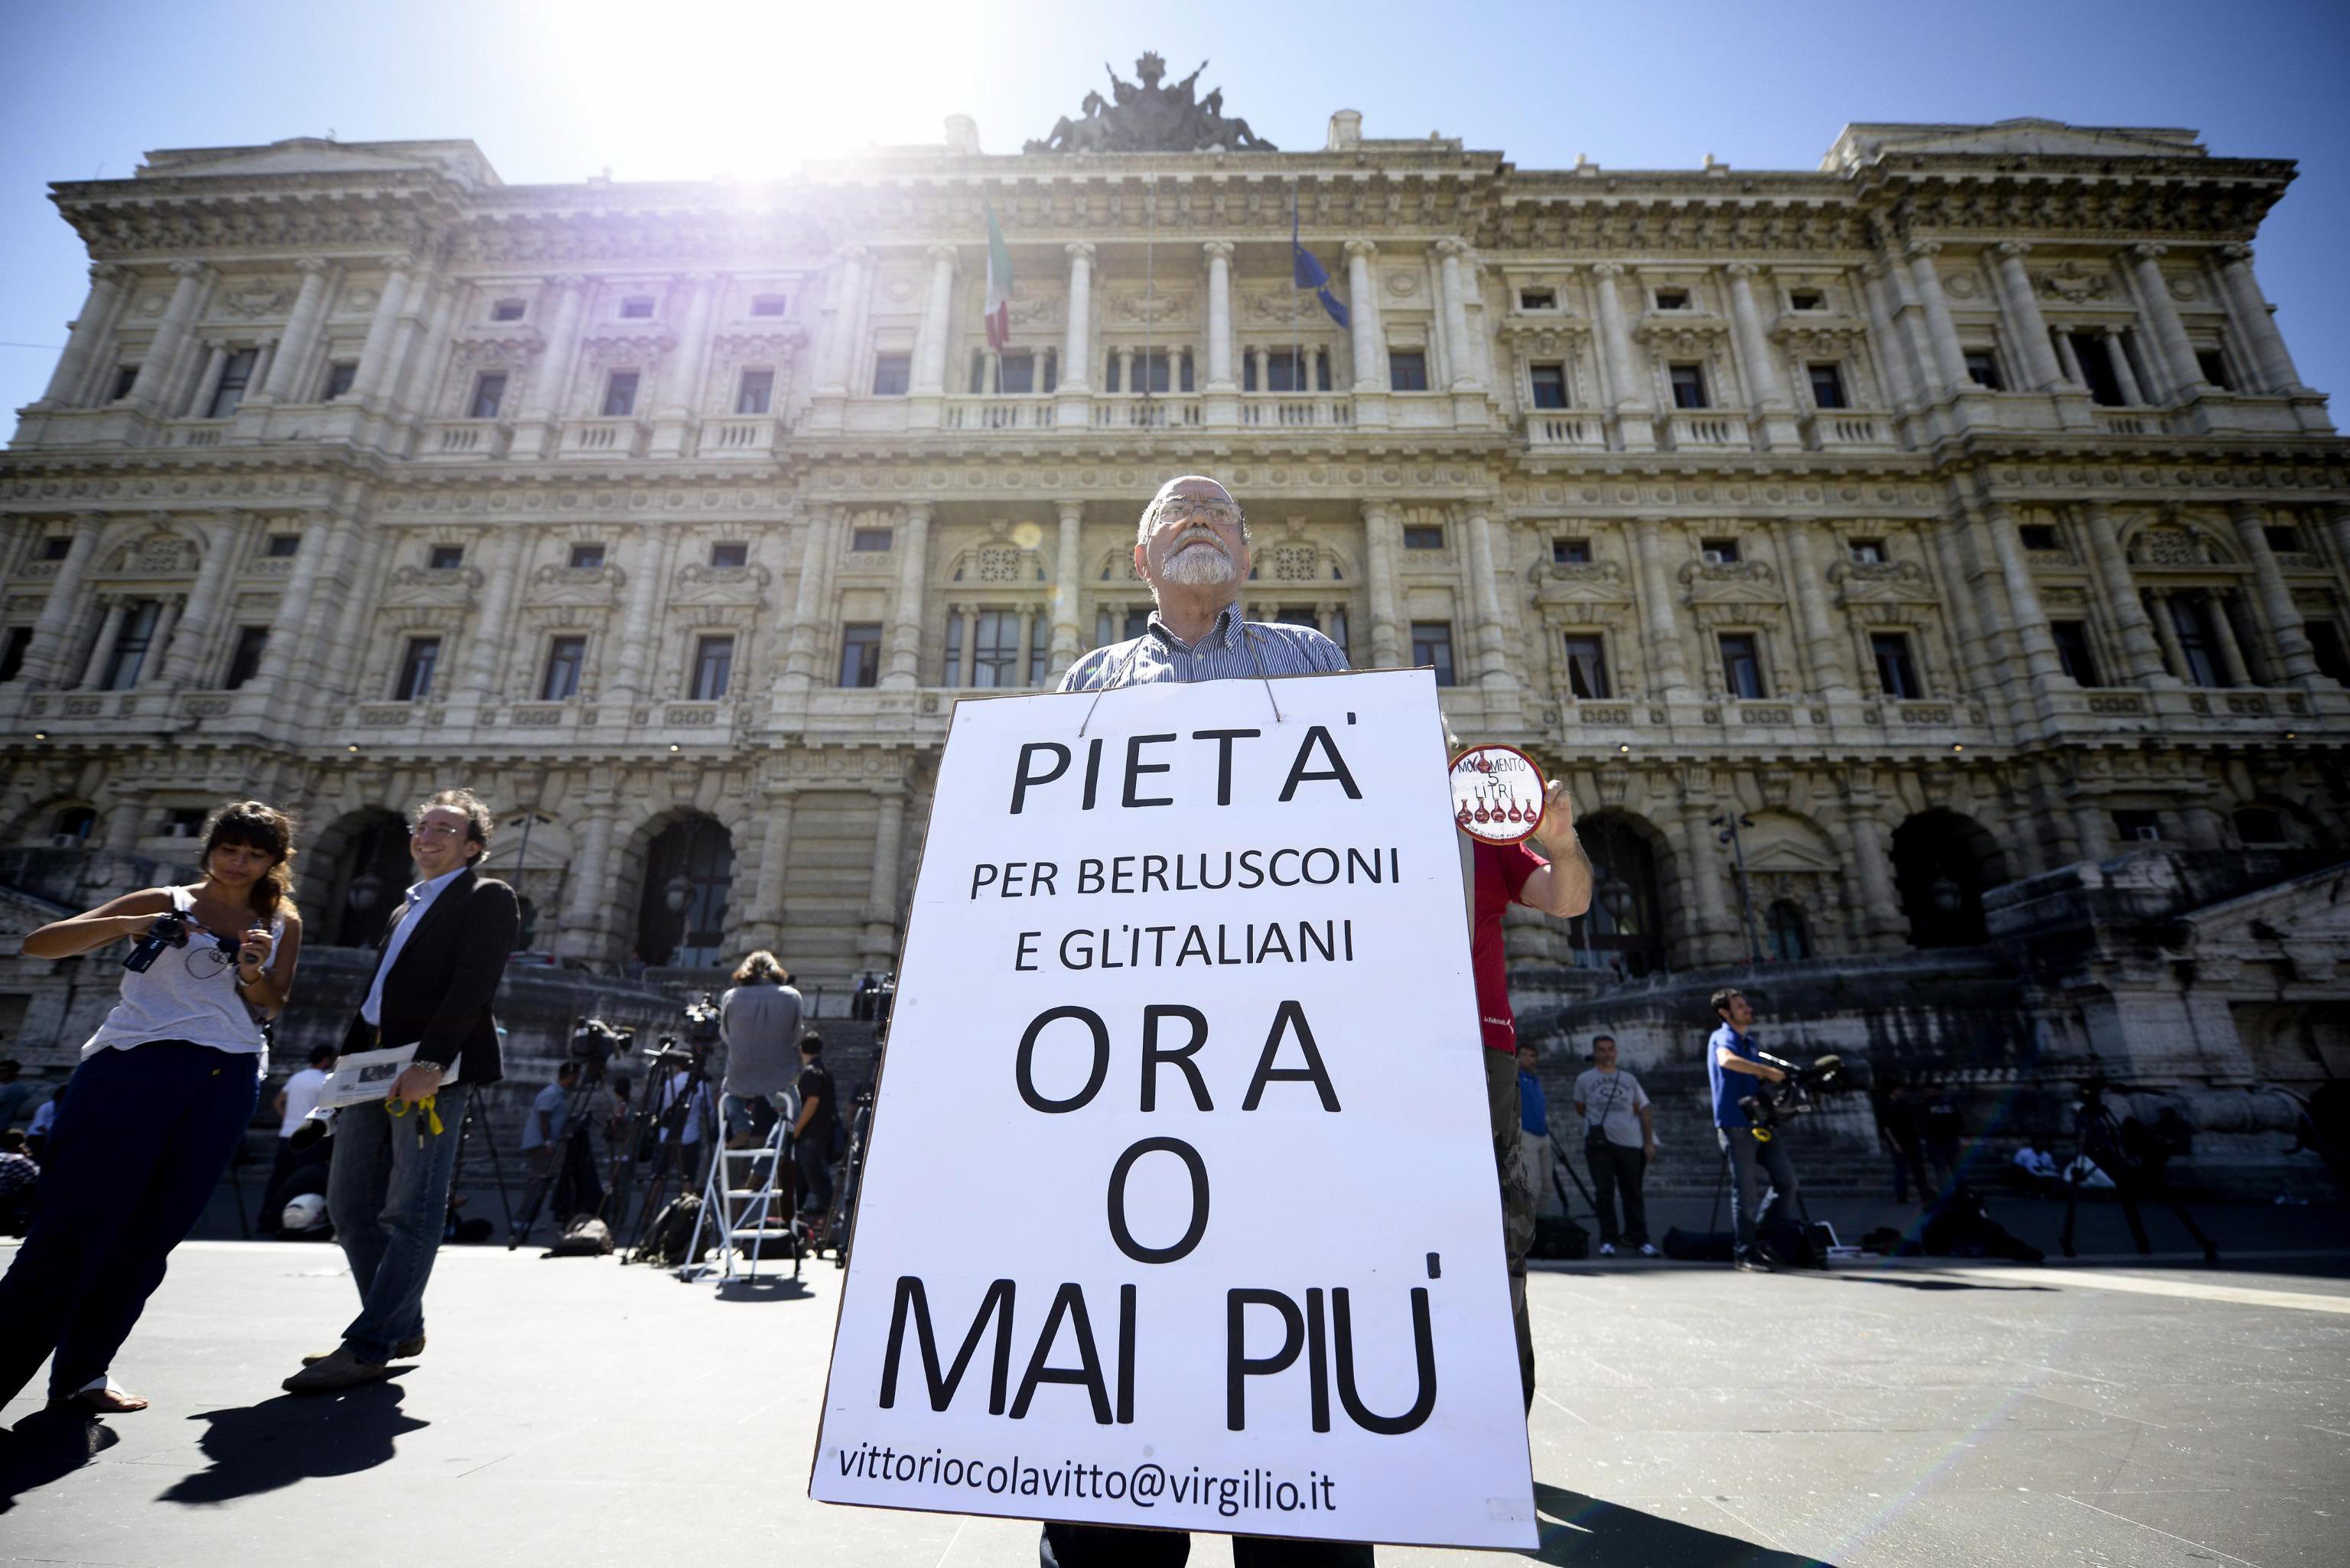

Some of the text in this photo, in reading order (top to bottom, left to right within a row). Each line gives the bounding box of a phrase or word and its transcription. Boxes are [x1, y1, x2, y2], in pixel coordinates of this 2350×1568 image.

[1487, 771, 1499, 785] 5
[971, 847, 1399, 900] PER BERLUSCONI
[1015, 919, 1353, 971] E GL'ITALIANI
[1015, 1000, 1342, 1114] ORA
[1107, 1136, 1210, 1264] O
[878, 1275, 1137, 1425] MAI
[840, 1442, 1336, 1517] vittoriocolavitto@virgilio.it
